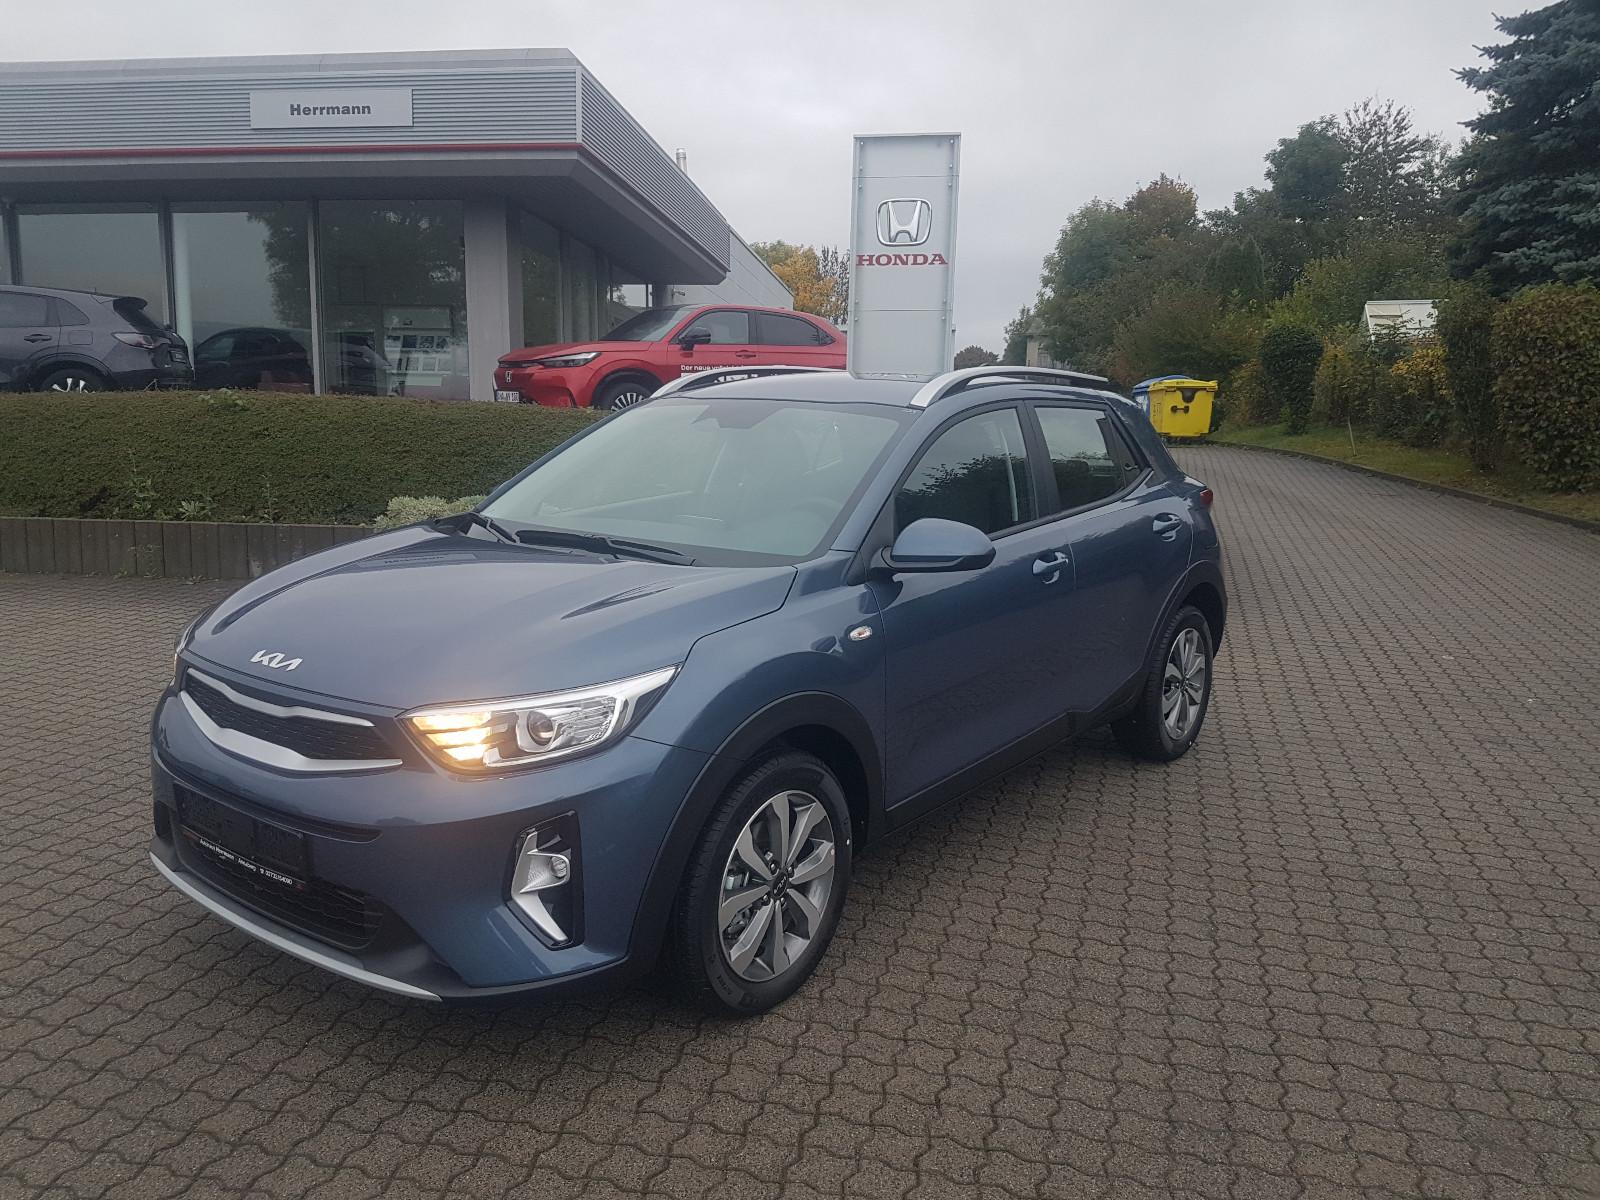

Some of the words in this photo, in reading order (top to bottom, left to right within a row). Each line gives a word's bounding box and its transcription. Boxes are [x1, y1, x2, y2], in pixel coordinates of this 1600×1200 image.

[289, 103, 372, 116] Herrmann
[856, 253, 948, 266] HONDA
[250, 649, 303, 672] KIA
